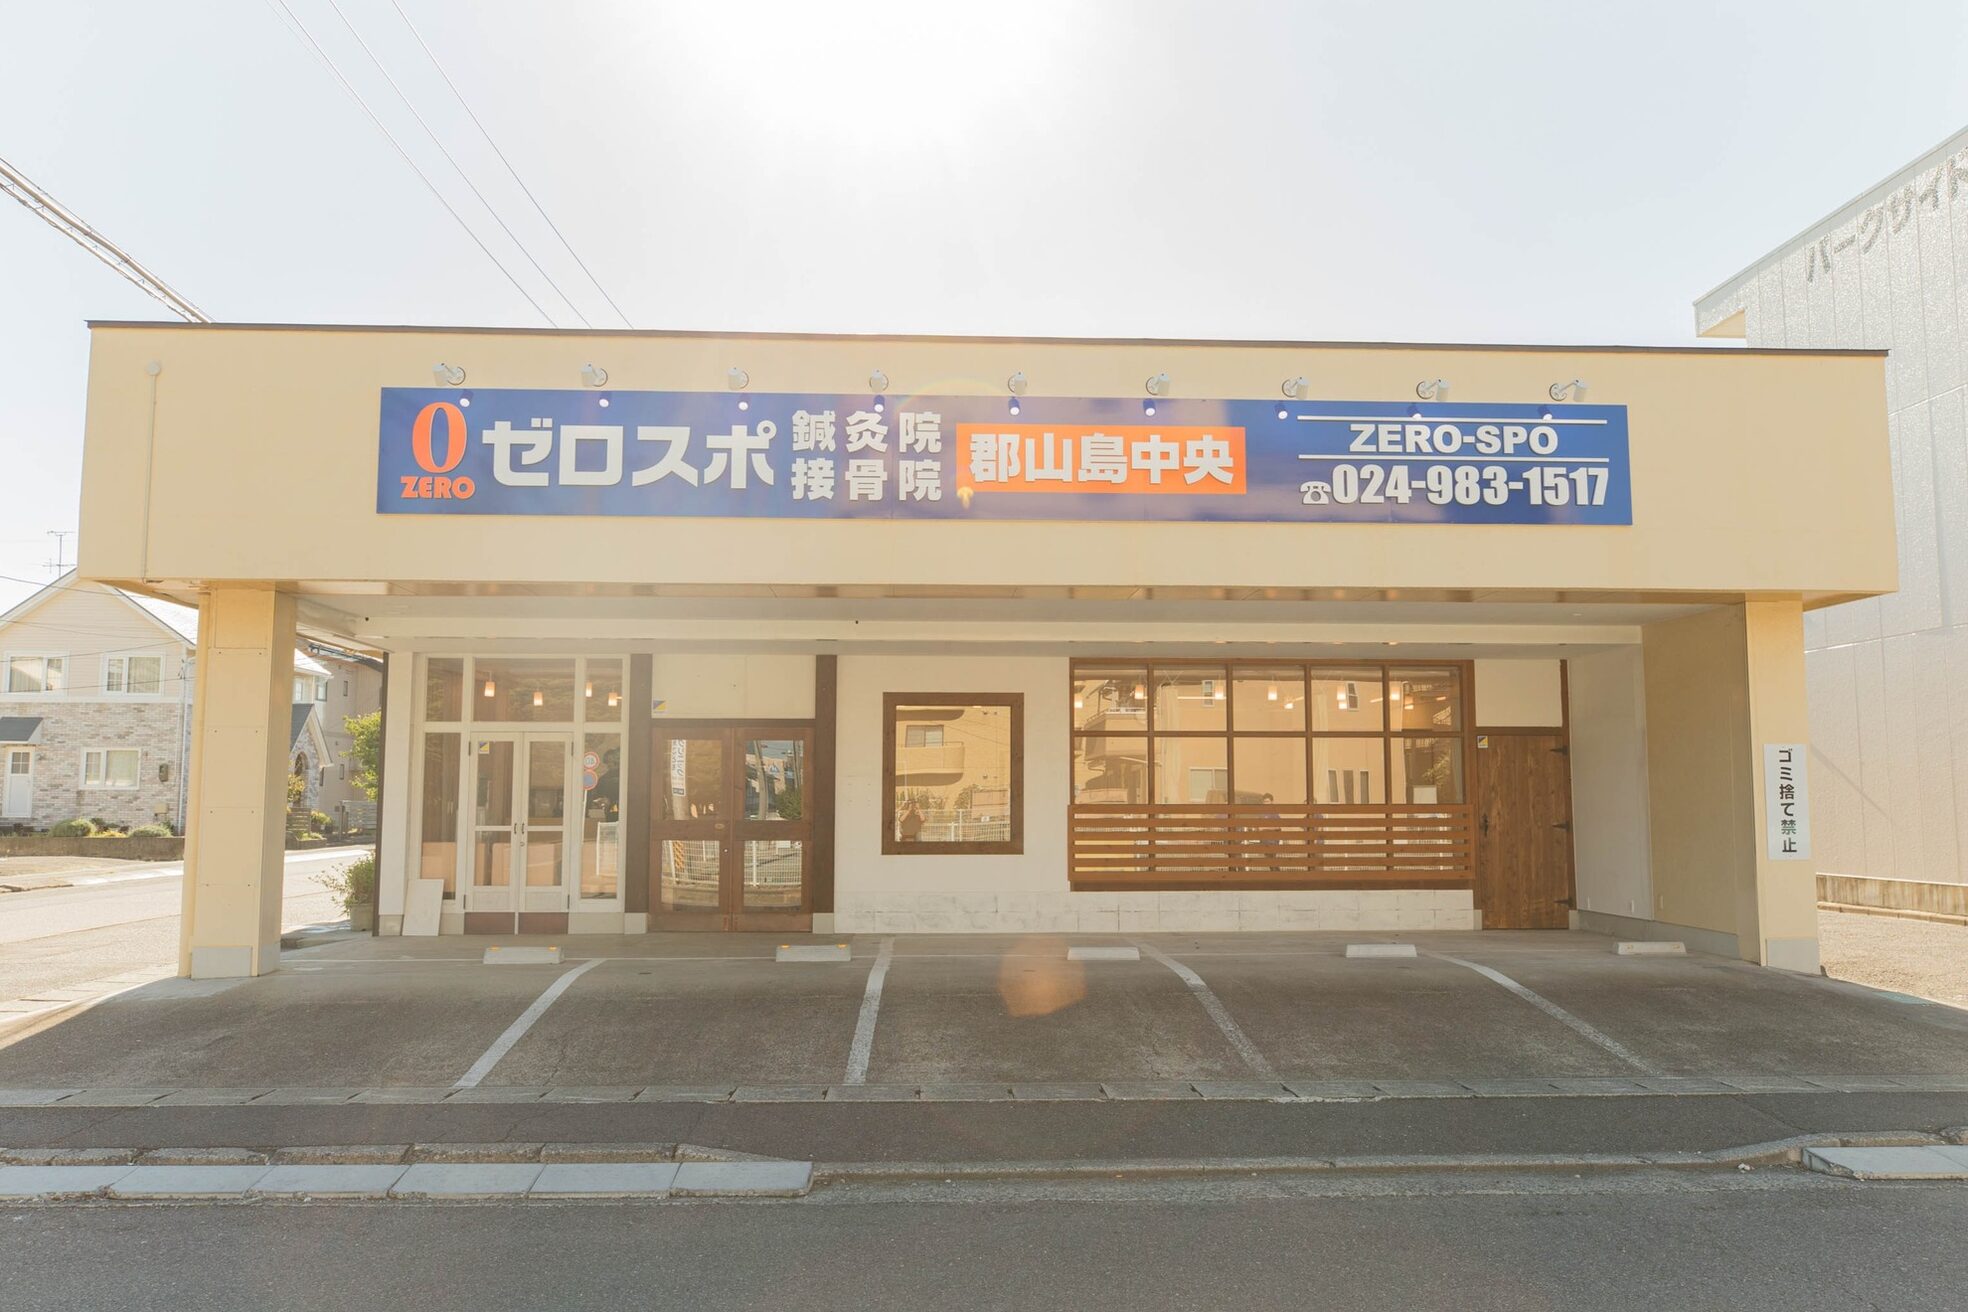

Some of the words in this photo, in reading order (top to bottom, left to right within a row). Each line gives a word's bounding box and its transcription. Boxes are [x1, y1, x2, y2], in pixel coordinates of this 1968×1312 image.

[792, 410, 942, 453] 鍼灸院
[1350, 424, 1559, 454] ZERO-SPO
[482, 418, 777, 489] ゼロスポ
[969, 433, 1234, 485] 郡山島中央
[401, 476, 476, 499] ZERO
[791, 458, 942, 501] 接骨院
[1332, 464, 1609, 506] 024-983-1517
[1779, 748, 1797, 853] ゴミ捨て禁止
